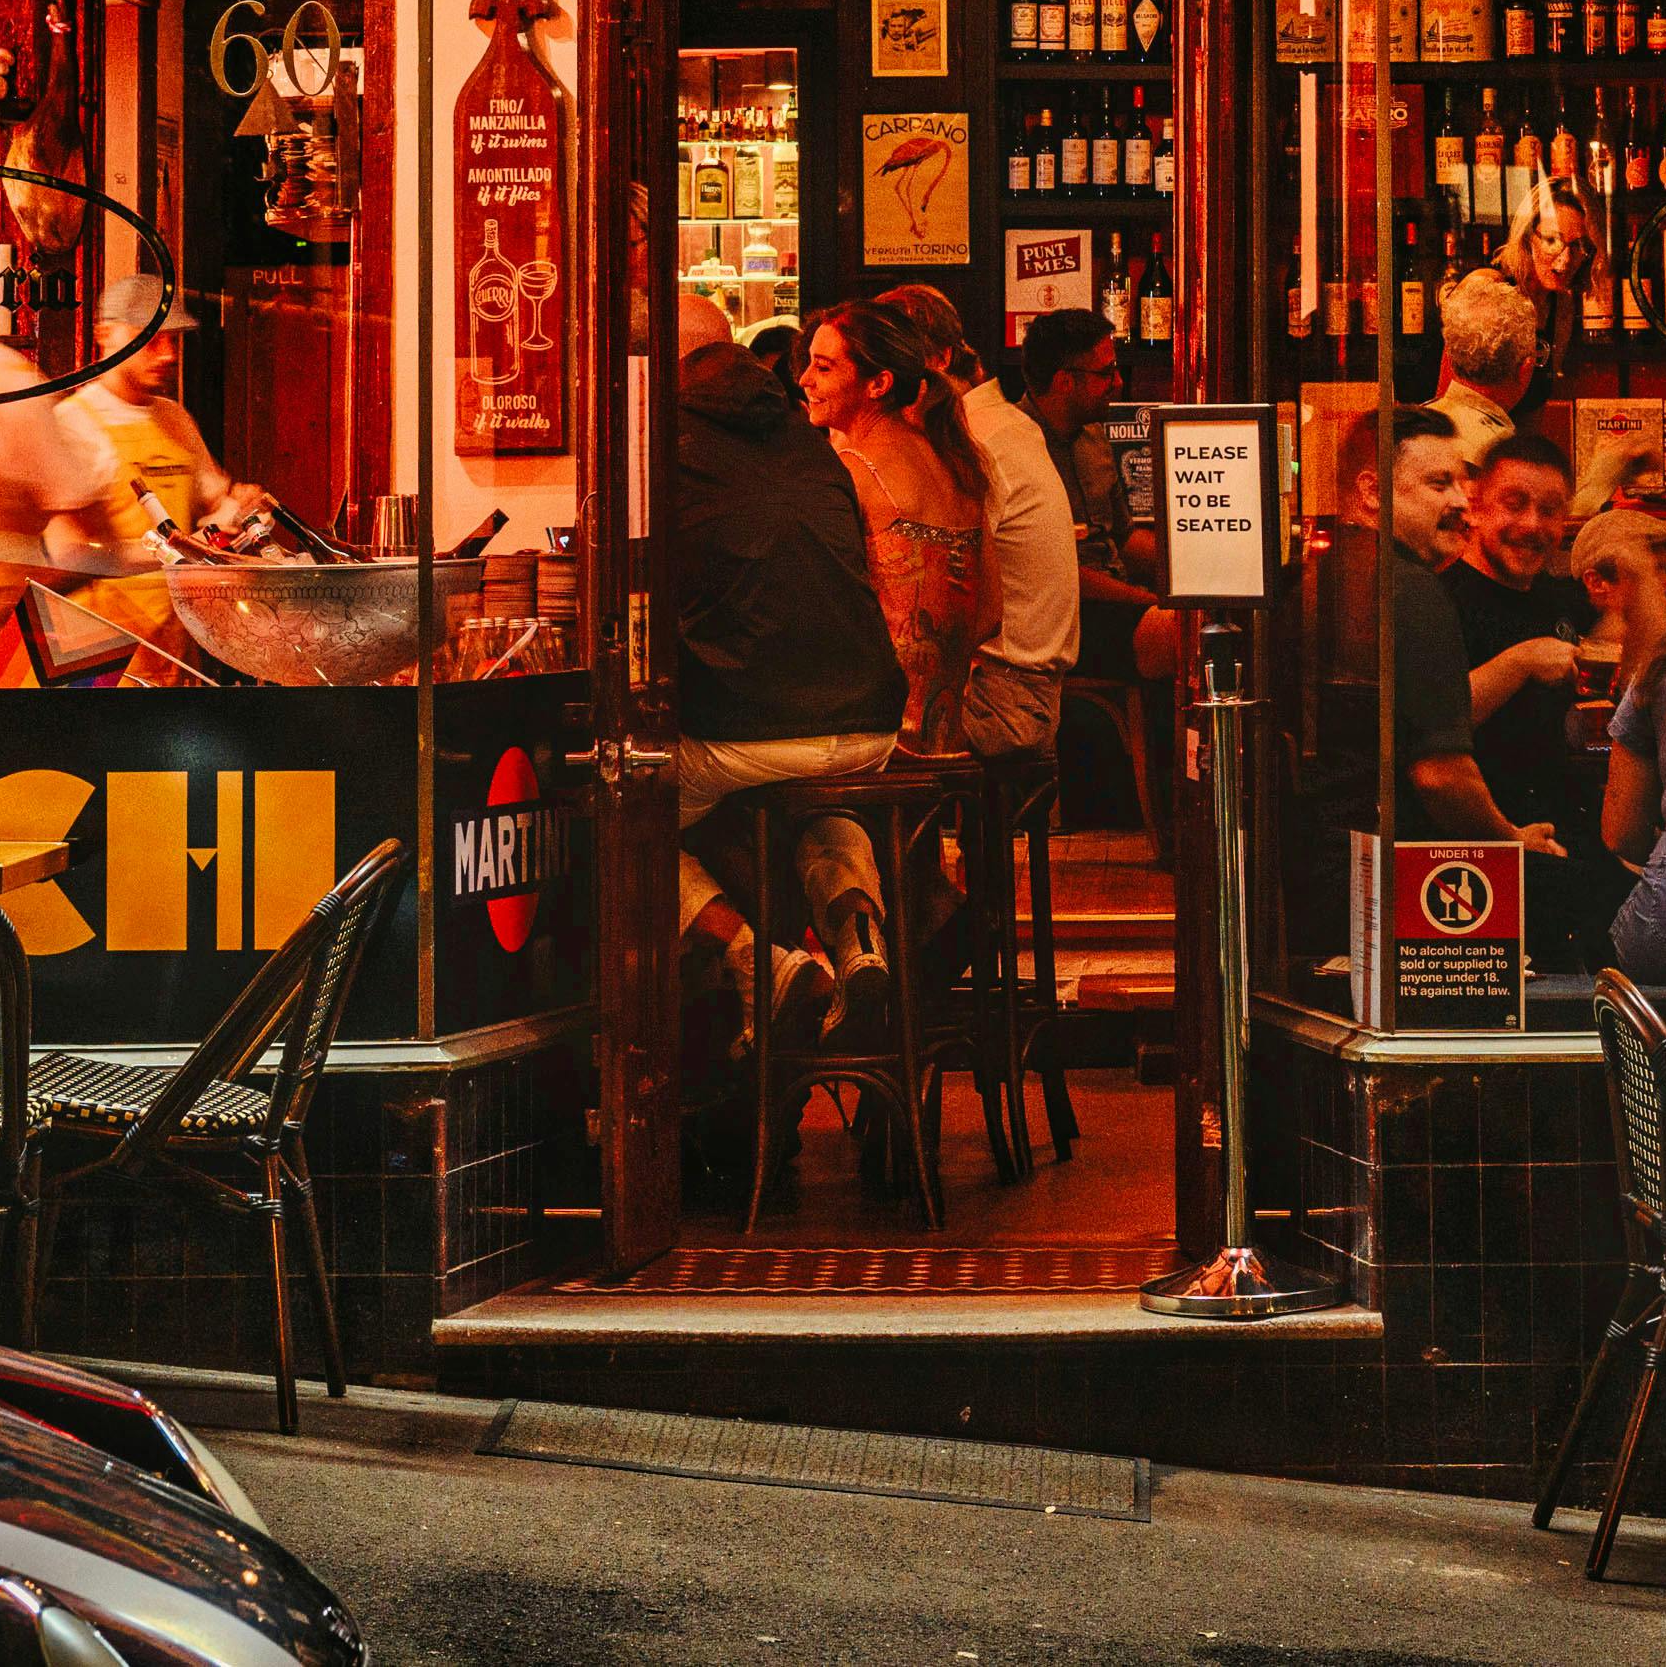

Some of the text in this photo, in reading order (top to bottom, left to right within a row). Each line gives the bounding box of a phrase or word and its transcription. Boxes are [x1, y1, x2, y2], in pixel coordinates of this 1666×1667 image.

[210, 0, 342, 98] 60
[489, 98, 524, 114] FINO/
[469, 115, 546, 131] MANZANILLA
[864, 117, 967, 144] CARPANO
[470, 133, 548, 153] if it swims
[467, 167, 552, 184] AMONTILLADO
[477, 185, 542, 206] if it flies
[913, 243, 968, 256] TORINO
[1022, 242, 1067, 262] PUNT
[1034, 256, 1077, 275] MES
[253, 269, 303, 284] PULL
[482, 395, 537, 411] OLOROSO
[505, 412, 551, 430] walks
[1598, 420, 1642, 430] MARTINI
[1109, 424, 1150, 439] NOILLY
[1174, 446, 1249, 460] PLEASE
[1175, 470, 1226, 484] WAIT
[1175, 494, 1231, 508] TO BE
[1176, 518, 1252, 532] SEATED
[1429, 849, 1484, 859] UNDER 18
[1400, 945, 1505, 956] No alcohol can be
[1400, 959, 1508, 971] sold or supplied to
[1400, 972, 1500, 986] anyone under 18.
[1400, 986, 1511, 999] It's against the law.
